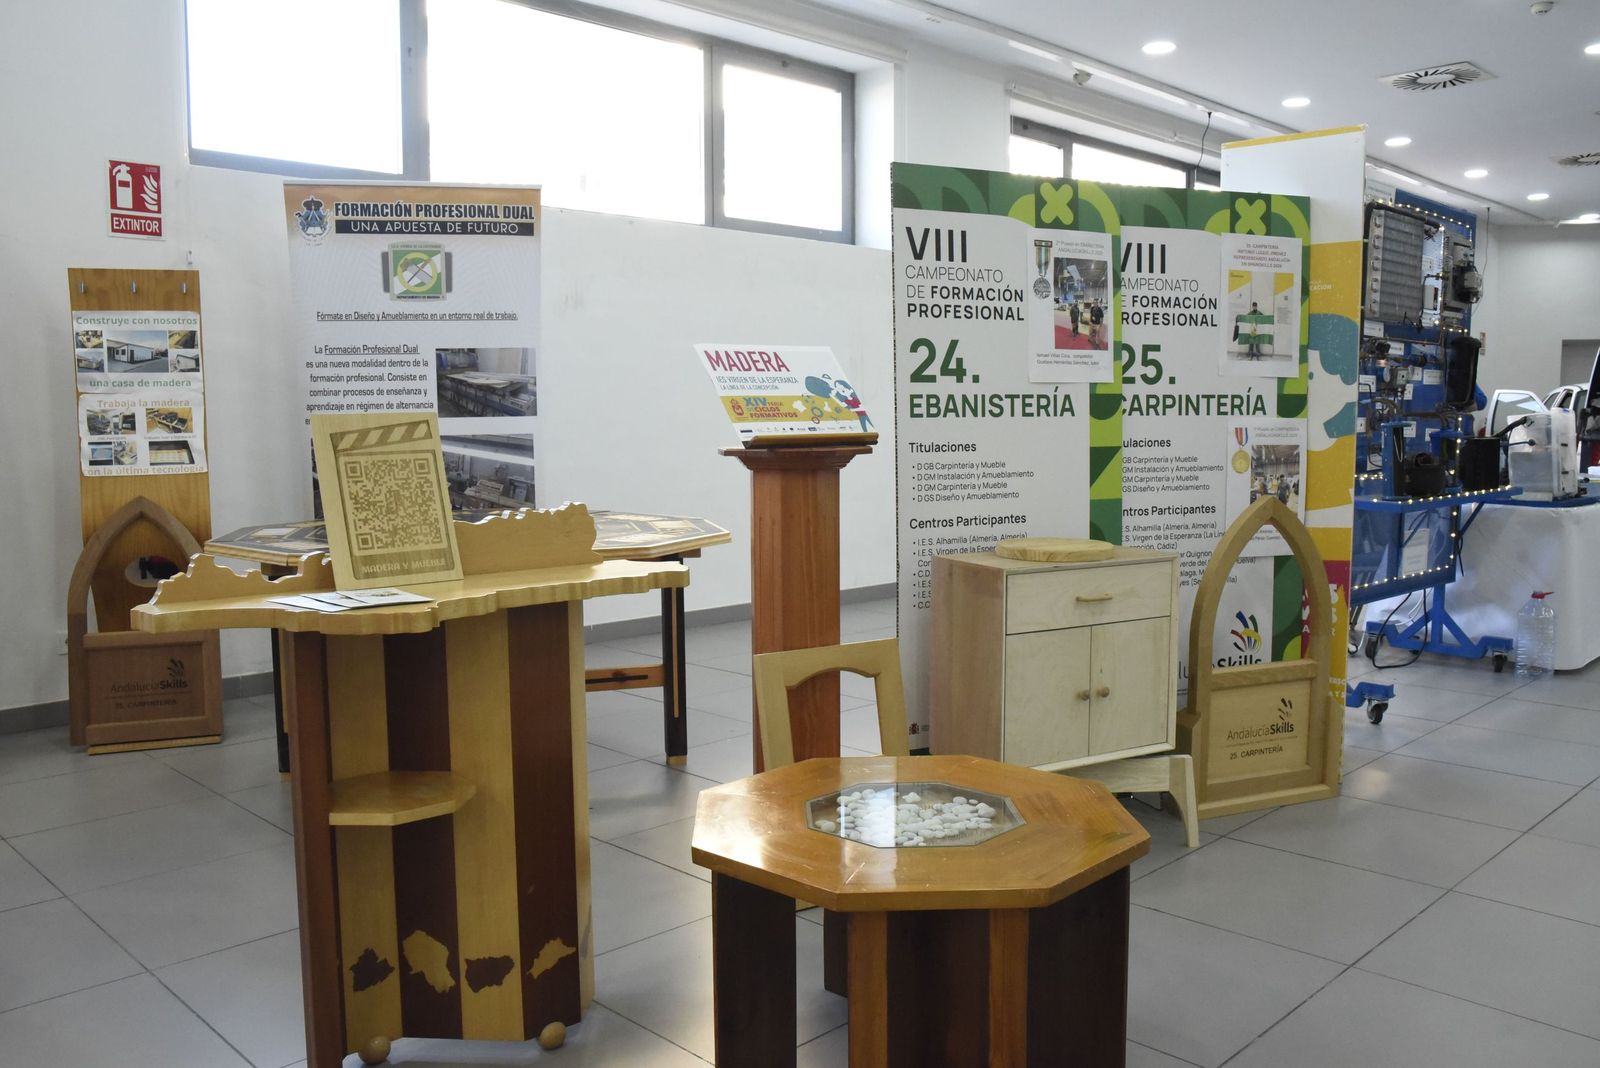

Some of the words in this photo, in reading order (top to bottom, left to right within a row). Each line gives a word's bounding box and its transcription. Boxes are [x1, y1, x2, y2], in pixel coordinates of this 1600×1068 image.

[335, 201, 412, 218] FORMACIÓN
[415, 204, 500, 219] PROFESIONAL
[503, 205, 535, 220] DUAL
[113, 217, 160, 233] EXTINTOR
[351, 221, 380, 232] UNA
[385, 222, 441, 233] APUESTA
[447, 222, 463, 233] DE
[467, 223, 519, 234] FUTURO
[905, 226, 967, 262] VIII
[905, 265, 1003, 283] CAMPEONATO
[1120, 277, 1199, 293] AMPEONATO
[907, 285, 926, 299] DE
[931, 284, 1024, 302] FORMACIÓN
[1132, 294, 1218, 310] FORMACIÓN
[316, 311, 344, 321] Fórmate
[345, 312, 353, 321] en
[353, 311, 376, 321] Diseño
[381, 311, 429, 321] Amueblamiento
[430, 312, 438, 321] en
[439, 312, 447, 321] un
[448, 312, 472, 321] entorno
[473, 311, 486, 321] real
[486, 311, 494, 320] de
[495, 311, 519, 321] trabajo.
[907, 303, 1025, 321] PROFESIONAL
[76, 316, 130, 327] Construye
[153, 317, 198, 325] nosotros
[1121, 312, 1218, 327] ROFESIONAL
[314, 345, 323, 354] La
[325, 345, 361, 355] Formación
[362, 344, 401, 354] Profesional
[403, 344, 419, 354] Dual
[329, 360, 350, 368] nueva
[351, 359, 387, 368] modalidad
[388, 359, 411, 368] dentro
[412, 359, 421, 367] de
[422, 358, 429, 367] la
[703, 350, 791, 373] MADERA
[909, 338, 980, 384] 24.
[89, 380, 109, 388] una
[112, 380, 135, 388] casa
[137, 379, 150, 388] de
[153, 379, 192, 388] madera
[310, 373, 345, 383] formación
[346, 373, 385, 384] profesional.
[387, 372, 417, 382] Consiste
[418, 374, 427, 382] en
[728, 376, 749, 384] VIRGEN
[750, 376, 758, 384] DE
[760, 376, 767, 384] LA
[767, 376, 799, 384] ESPERANZA
[309, 388, 341, 397] combinar
[342, 388, 375, 399] procesos
[376, 387, 385, 396] de
[386, 387, 422, 396] enseñanza
[423, 388, 428, 398] y
[97, 400, 136, 409] Trabaja
[139, 399, 148, 407] la
[151, 399, 190, 407] madera
[306, 402, 345, 413] aprendizaje
[346, 403, 355, 411] en
[356, 401, 385, 413] régimen
[385, 401, 395, 410] de
[396, 400, 434, 410] alternancia
[743, 397, 768, 407] XIV
[909, 386, 1076, 418] EBANISTERÍA
[909, 442, 977, 453] Titulaciones
[1123, 438, 1171, 448] ulaciones
[1175, 455, 1198, 463] Mueble
[103, 467, 113, 475] la
[152, 464, 204, 475] tecnología
[917, 462, 923, 471] D
[924, 462, 935, 470] GB
[975, 462, 980, 471] y
[981, 460, 1006, 469] Mueble
[1134, 464, 1170, 473] Instalación
[1175, 464, 1224, 472] Amueblamiento
[917, 473, 923, 481] D
[924, 472, 936, 481] GM
[937, 471, 976, 480] Instalación
[976, 472, 981, 481] y
[982, 470, 1034, 479] Amueblamiento
[1176, 474, 1199, 482] Mueble
[917, 483, 923, 492] D
[924, 483, 936, 491] GM
[977, 483, 982, 492] y
[982, 481, 1008, 490] Mueble
[1133, 484, 1156, 493] Diseño
[1161, 483, 1210, 492] Amueblamiento
[917, 494, 923, 502] D
[924, 494, 935, 502] GS
[936, 492, 960, 502] Diseño
[961, 494, 966, 502] y
[966, 491, 1020, 500] Amueblamiento
[1122, 505, 1149, 517] ntros
[1151, 504, 1217, 517] Participantes
[909, 517, 954, 529] Centros
[956, 513, 1027, 528] Participantes
[1132, 523, 1161, 532] Alhamilla
[936, 535, 968, 545] Alhamilla
[1132, 534, 1153, 543] Virgen
[1153, 532, 1162, 541] de
[1162, 532, 1169, 540] la
[1170, 530, 1203, 541] Esperanza
[1203, 530, 1213, 540] (La
[936, 546, 958, 555] Virgen
[959, 545, 968, 554] de
[969, 544, 976, 554] la
[977, 543, 997, 553] Esper
[1156, 541, 1178, 551] Cádiz)
[362, 562, 401, 574] MADERA
[1197, 558, 1206, 567] del
[1226, 721, 1294, 740] AndalucíaSkills
[1241, 744, 1284, 758] CARPINTERÍA
